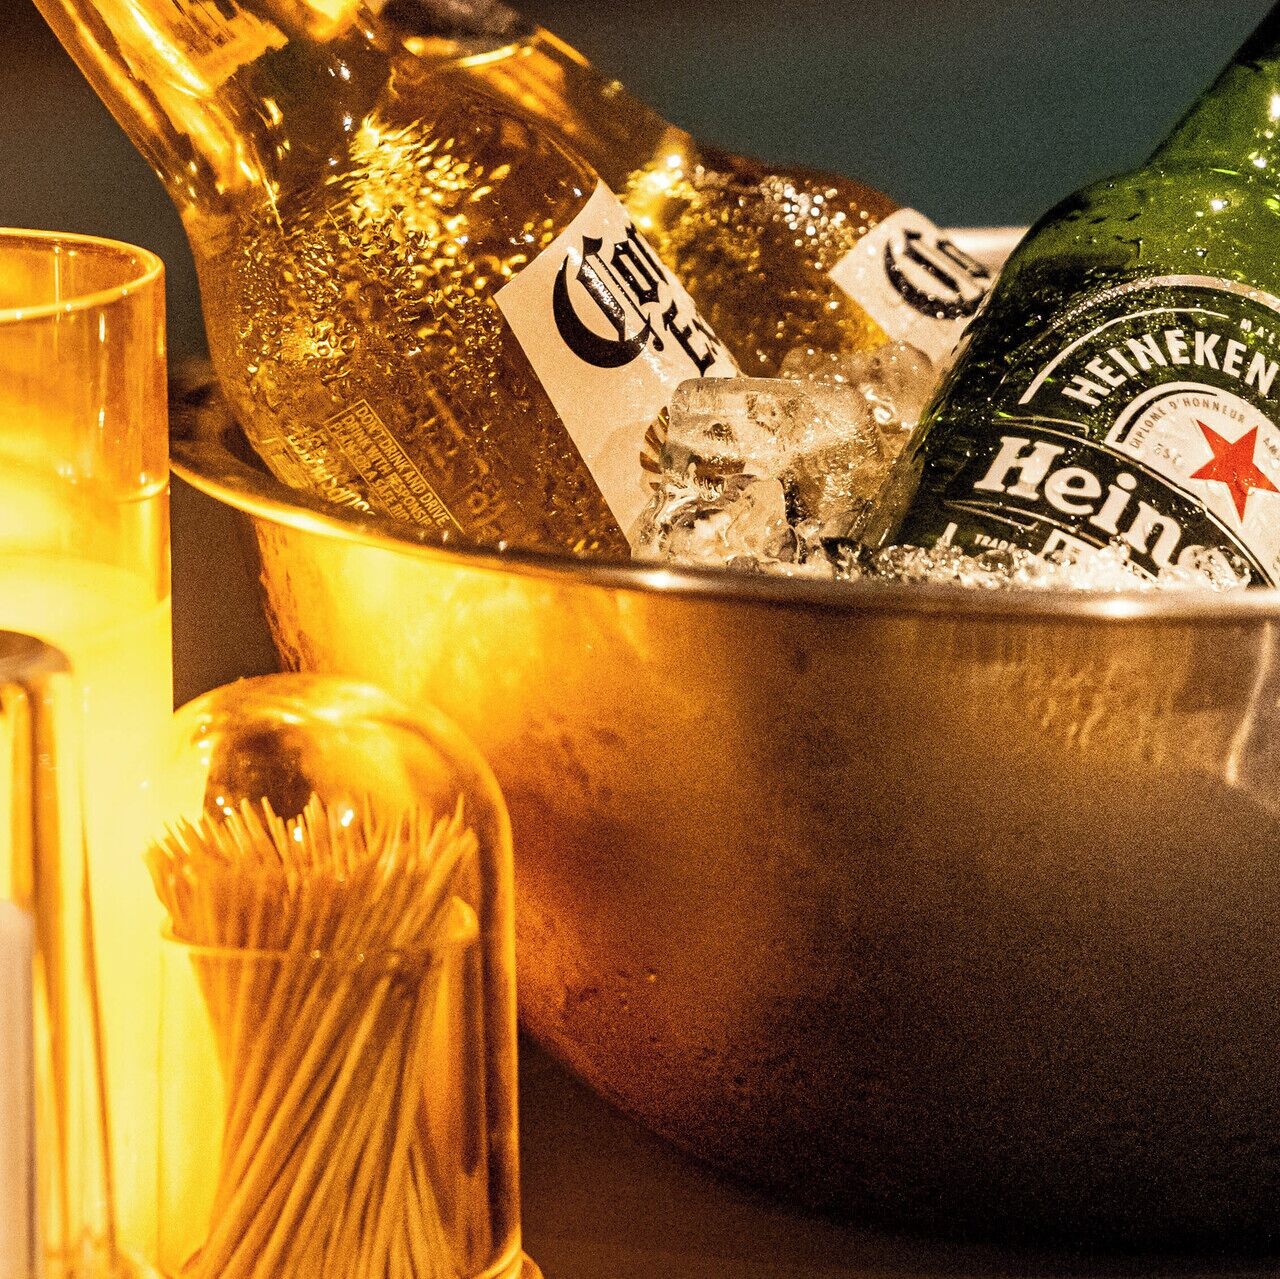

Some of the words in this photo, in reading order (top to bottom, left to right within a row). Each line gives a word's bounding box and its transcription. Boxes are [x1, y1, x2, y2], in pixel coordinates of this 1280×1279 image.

[1061, 330, 1279, 407] HEINEKEN
[378, 437, 410, 473] DRINK
[402, 468, 426, 495] AND
[419, 491, 450, 526] DRIVE
